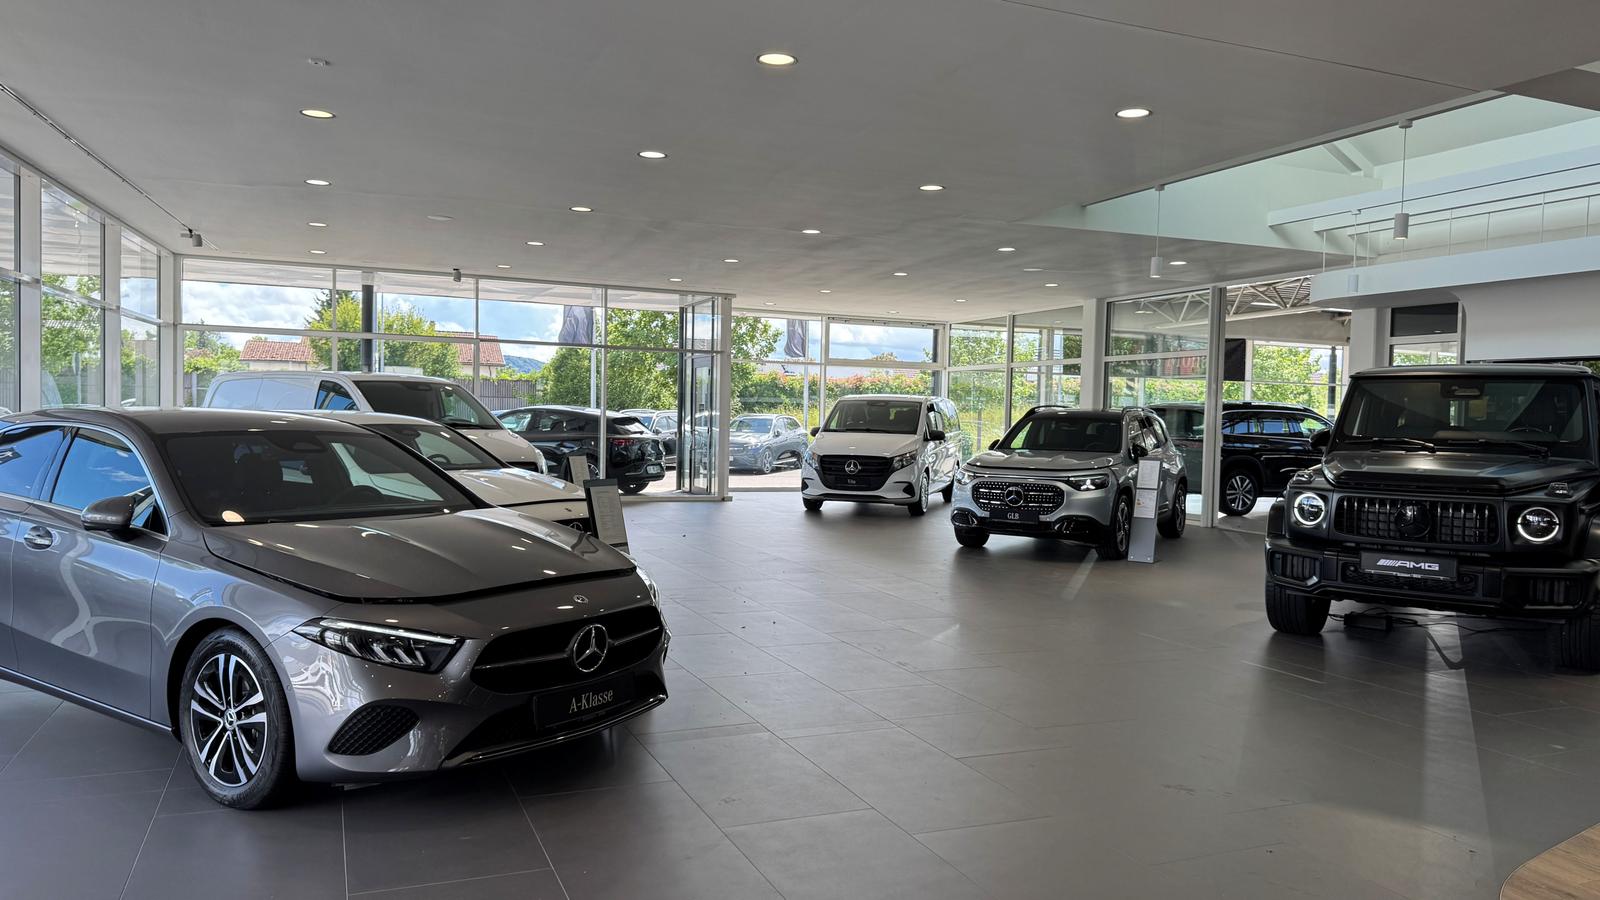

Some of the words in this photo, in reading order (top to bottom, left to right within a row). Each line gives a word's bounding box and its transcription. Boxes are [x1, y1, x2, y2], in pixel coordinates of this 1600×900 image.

[1007, 512, 1020, 520] GLB
[1395, 560, 1440, 571] AMG
[568, 689, 614, 714] A-Klasse
